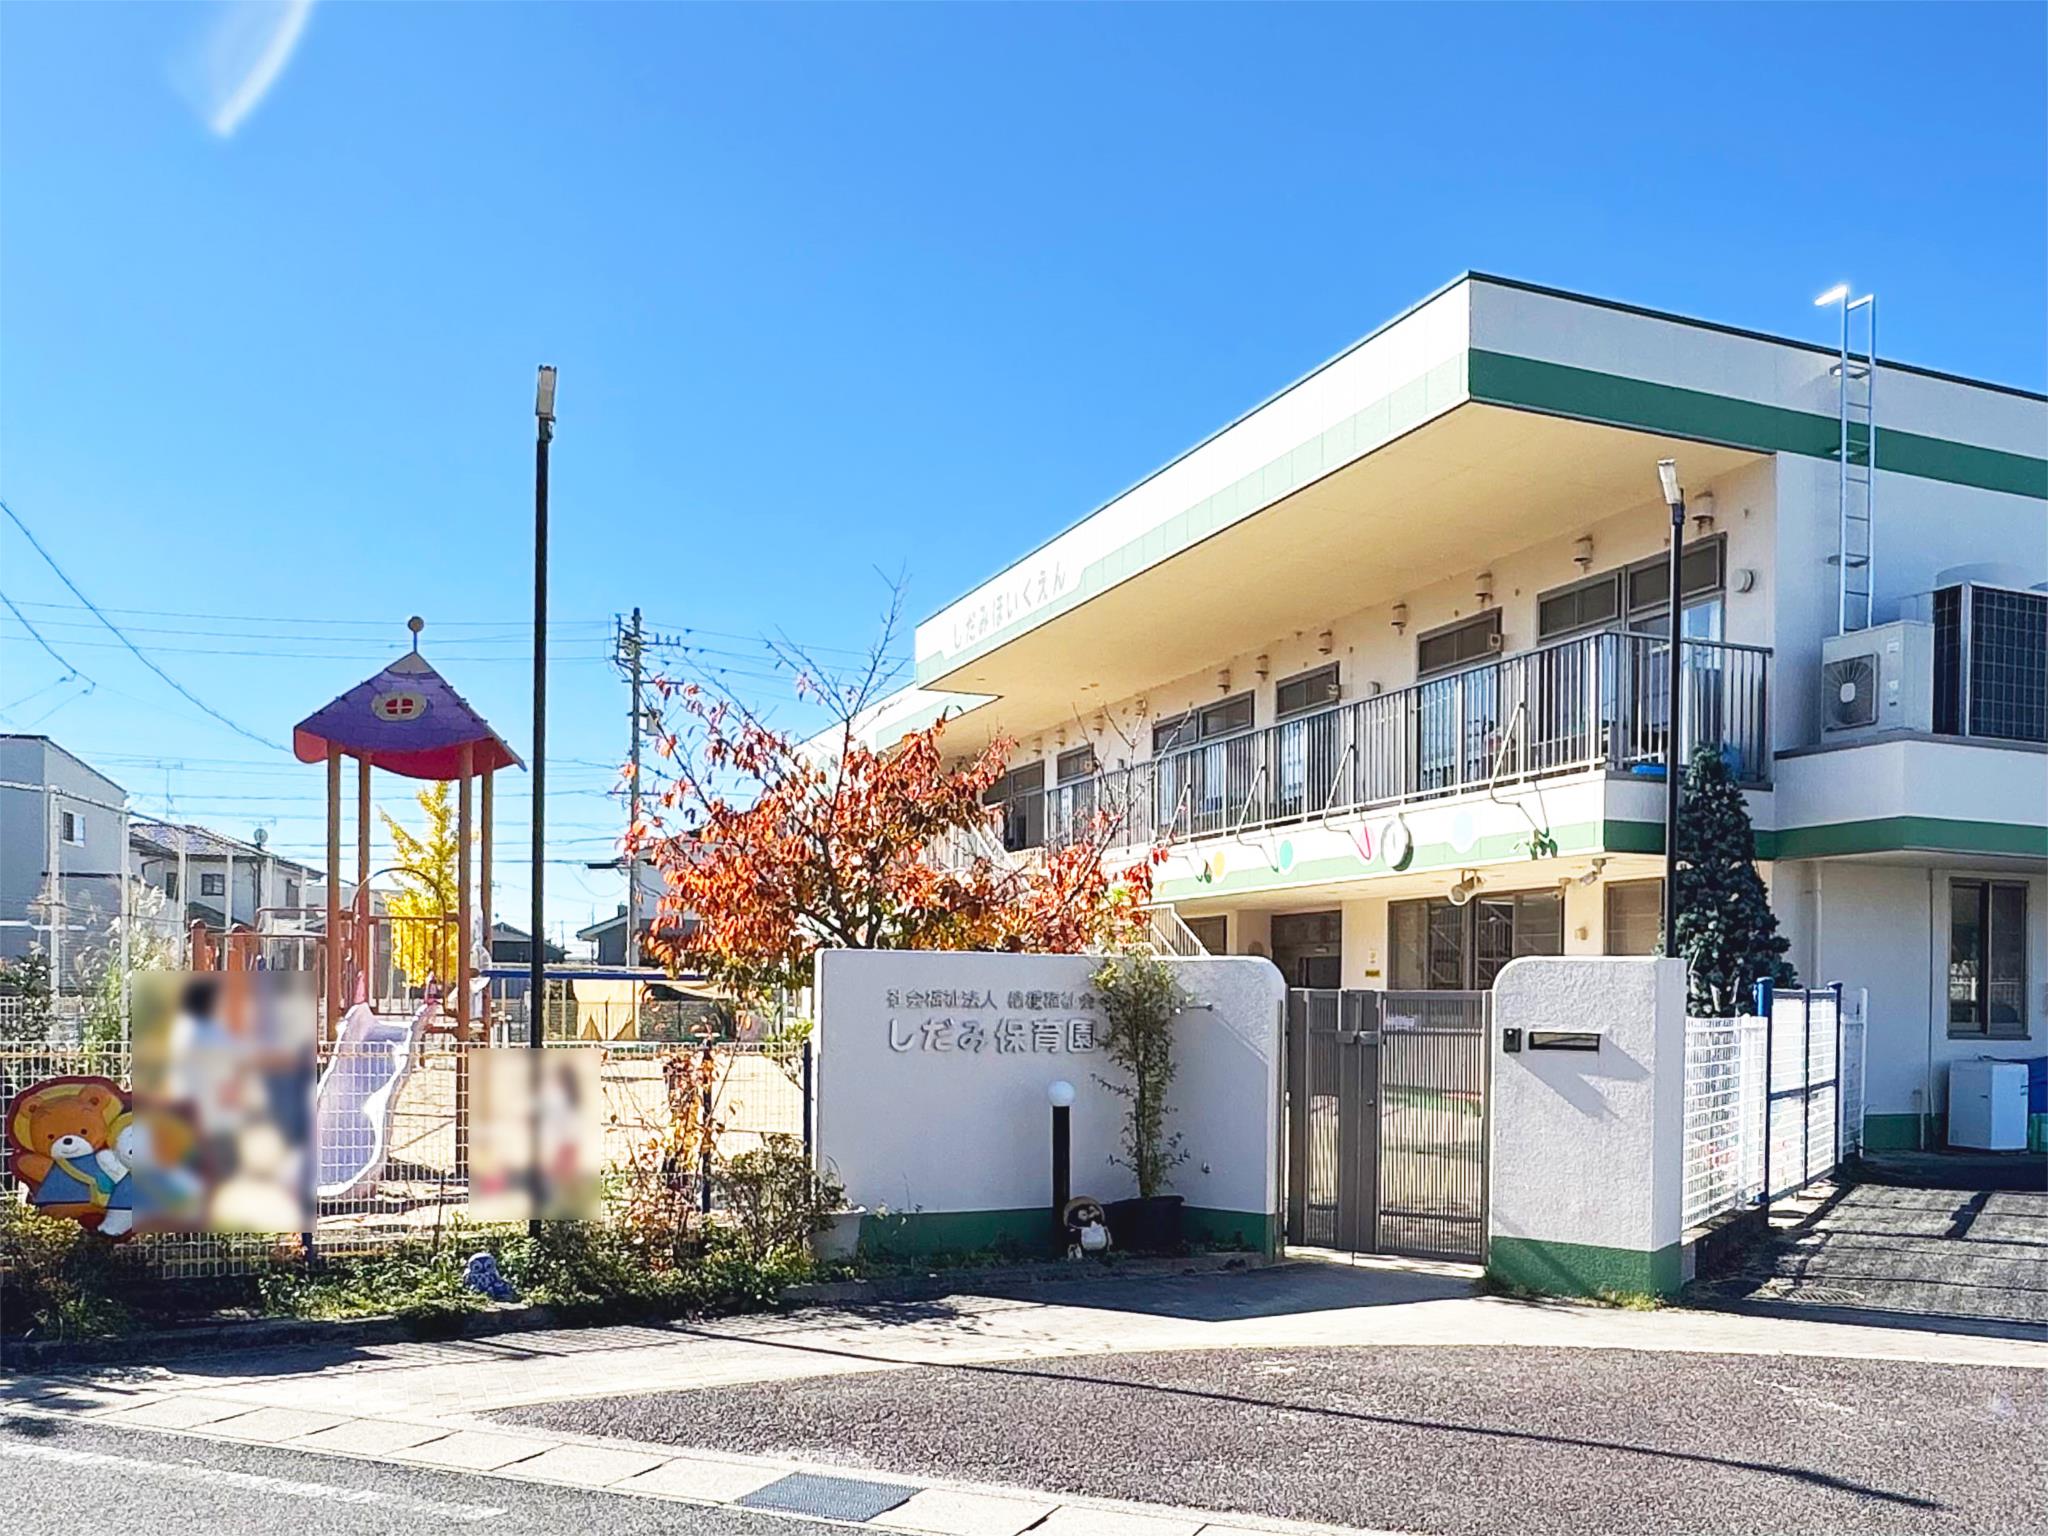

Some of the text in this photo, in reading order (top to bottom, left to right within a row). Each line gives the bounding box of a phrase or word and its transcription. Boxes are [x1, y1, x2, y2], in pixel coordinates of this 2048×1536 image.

[885, 988, 998, 1011] 社会福祉法人
[888, 1016, 1098, 1054] しだみ保育園
